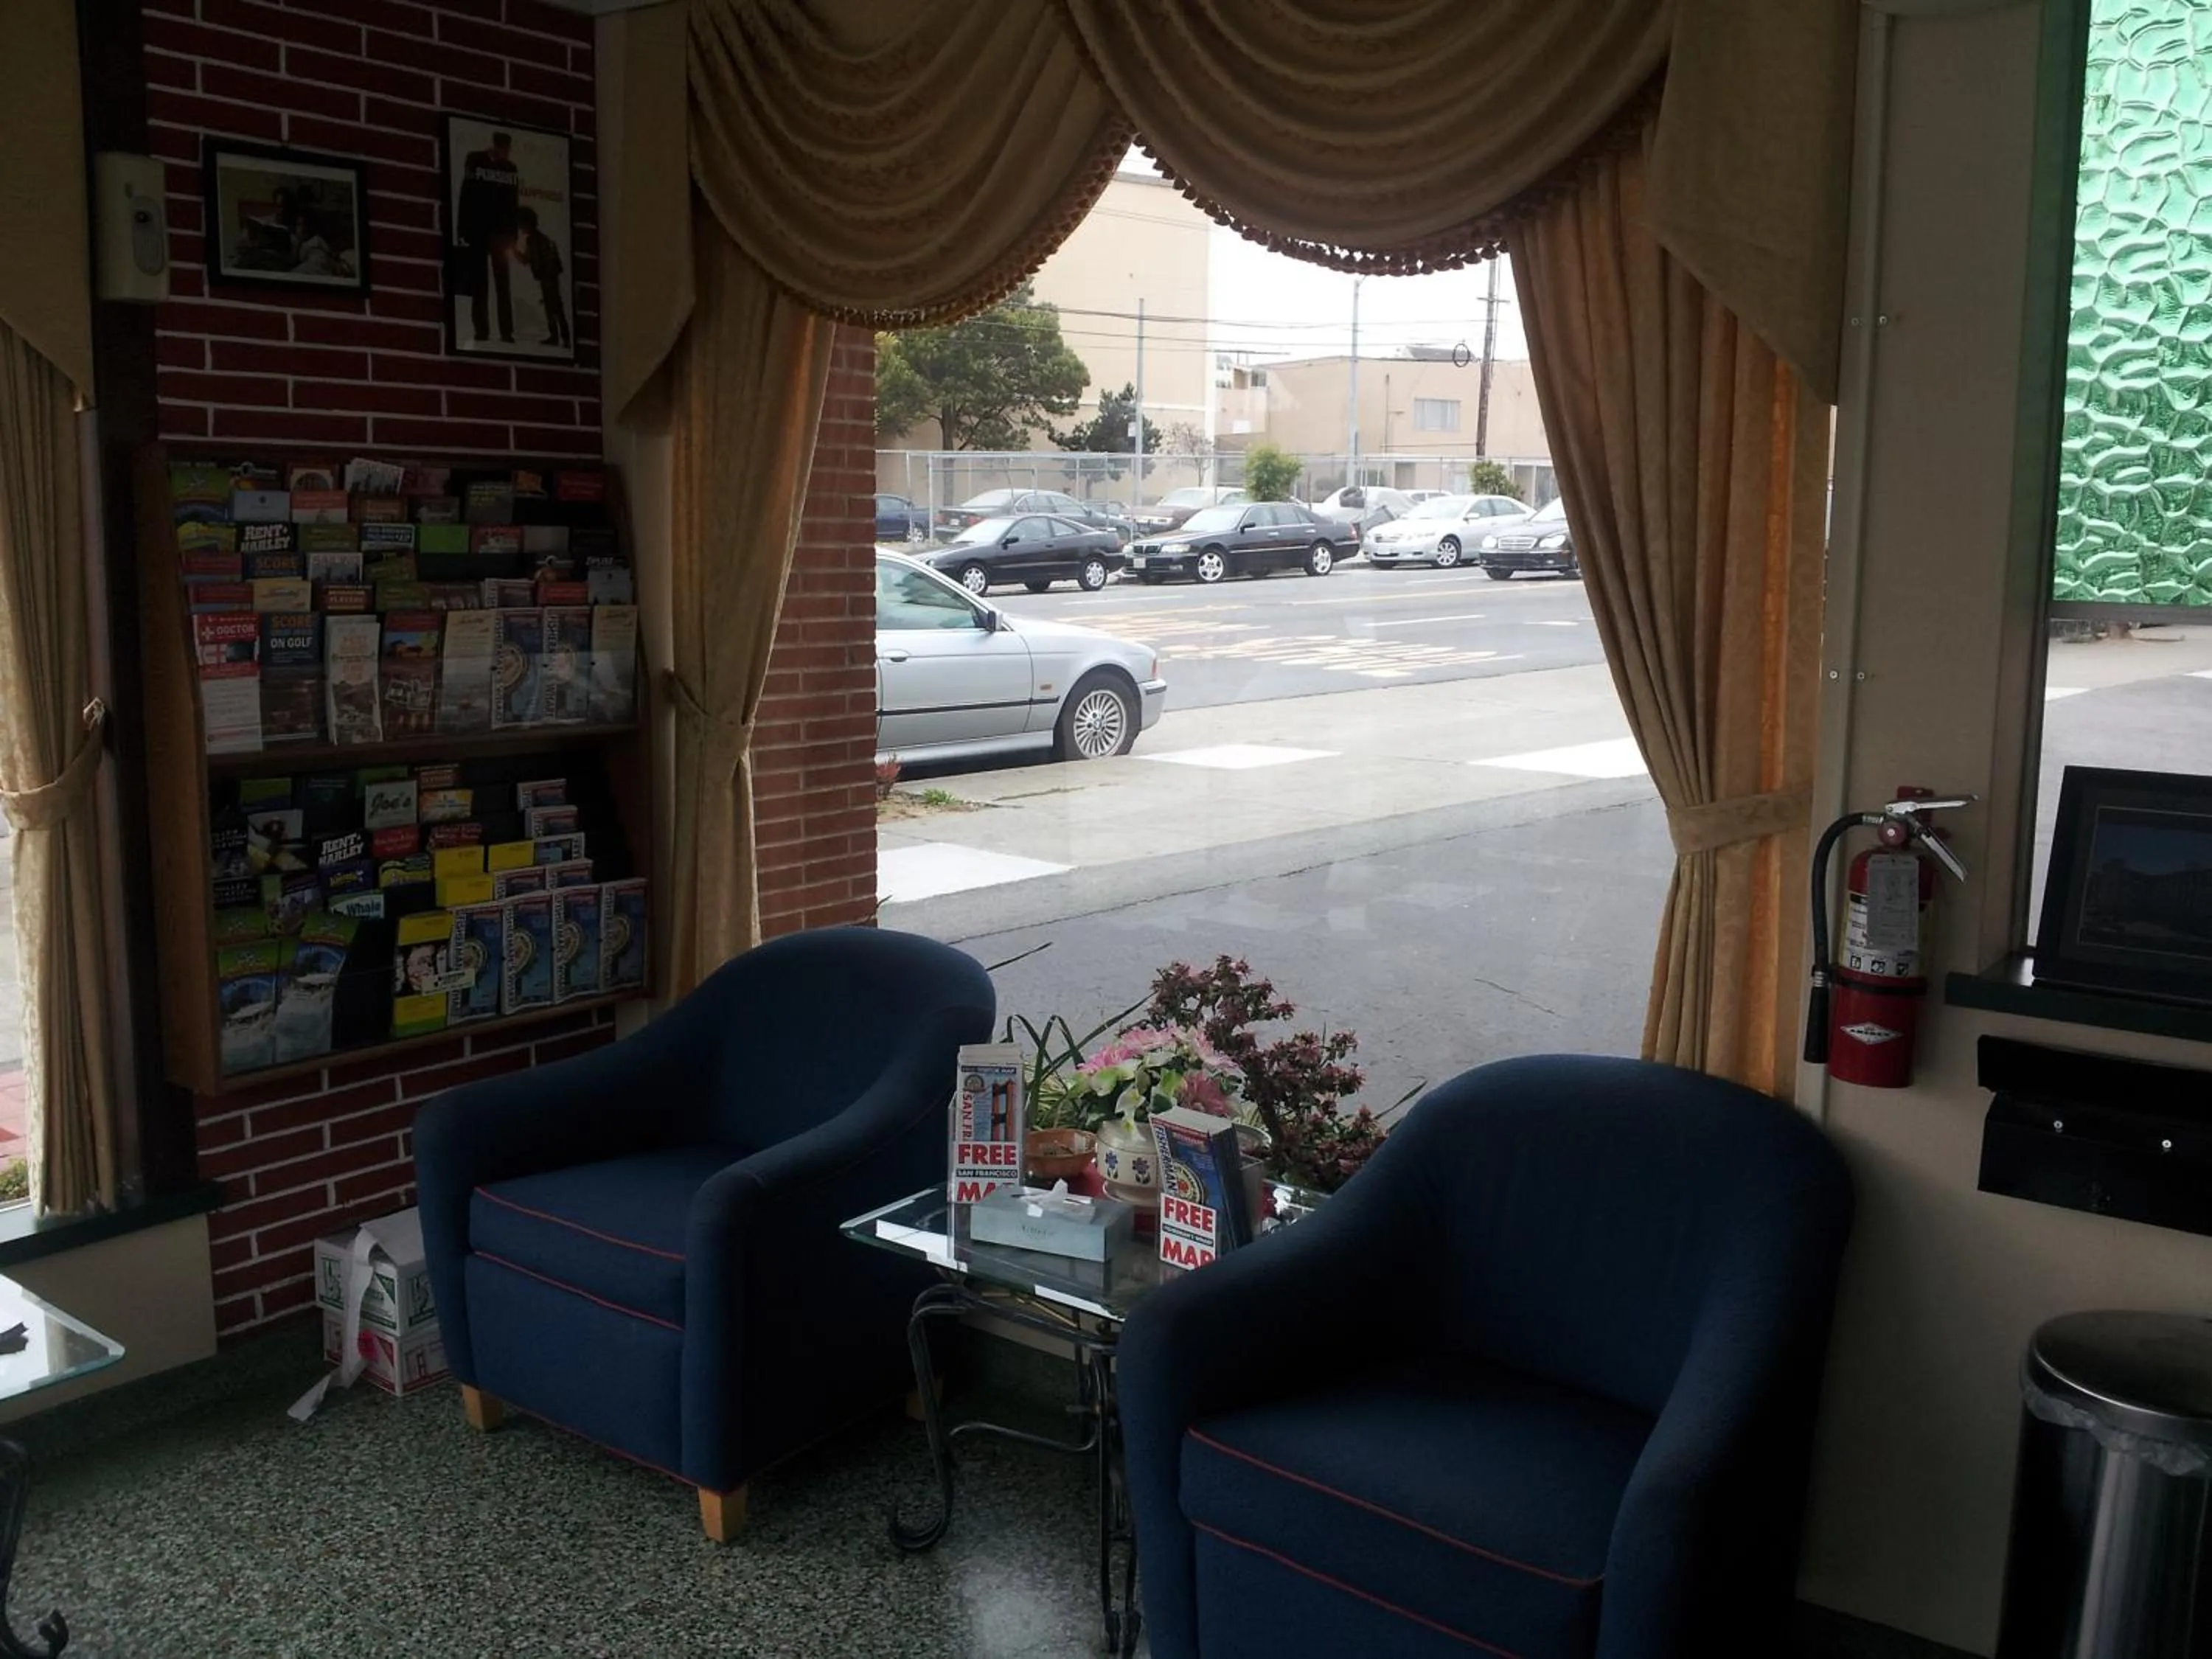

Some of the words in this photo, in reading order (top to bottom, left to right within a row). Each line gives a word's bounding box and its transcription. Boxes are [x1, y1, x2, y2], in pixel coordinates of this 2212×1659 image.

[244, 524, 284, 540] RENT
[216, 624, 255, 636] DOCTOR
[271, 639, 285, 649] ON
[287, 637, 313, 648] GOLF
[321, 832, 356, 854] RENT
[347, 900, 381, 917] Whale
[963, 1093, 973, 1120] SAN
[958, 1144, 1017, 1165] FREE
[959, 1169, 973, 1178] SAN
[1164, 1197, 1213, 1232] FREE
[1162, 1237, 1214, 1268] MAP
